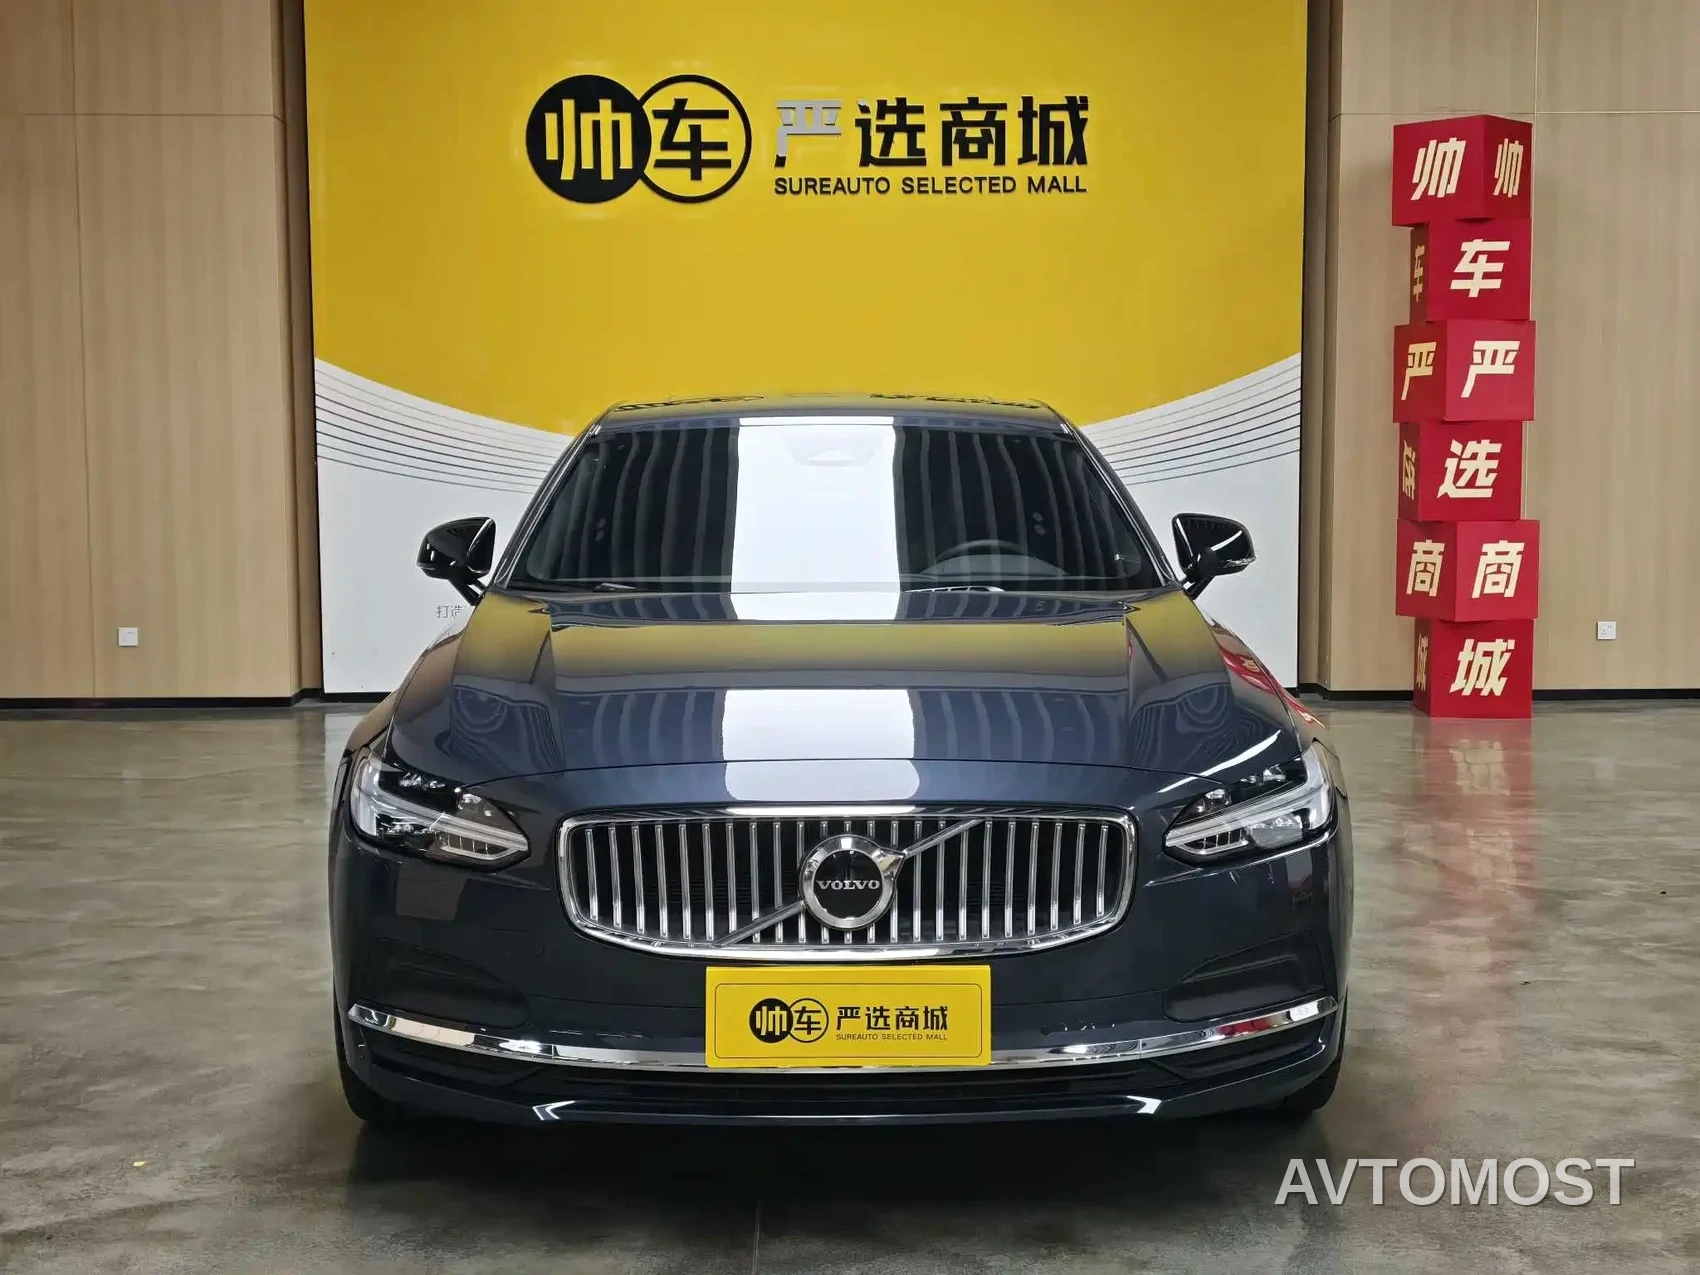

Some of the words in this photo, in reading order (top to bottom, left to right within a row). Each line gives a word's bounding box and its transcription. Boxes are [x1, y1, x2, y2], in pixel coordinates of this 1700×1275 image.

[774, 96, 1090, 168] 严选商城
[774, 176, 891, 196] SUREAUTO
[900, 176, 1017, 195] SELECTED
[1026, 175, 1088, 194] MALL
[1411, 137, 1467, 200] 帅
[1493, 138, 1524, 198] 帅
[1450, 238, 1511, 298] 车
[1400, 341, 1437, 400] 严
[1460, 340, 1520, 398] 严
[1436, 439, 1502, 499] 选
[1406, 539, 1445, 597] 商
[1471, 540, 1525, 599] 商
[1449, 638, 1515, 696] 城
[816, 880, 881, 890] VOLVO
[755, 1005, 822, 1036] 帅车
[836, 1005, 949, 1031] 严选商城
[836, 1033, 879, 1041] SUREAUTO
[881, 1033, 924, 1041] SELECTED
[925, 1033, 949, 1041] MALL
